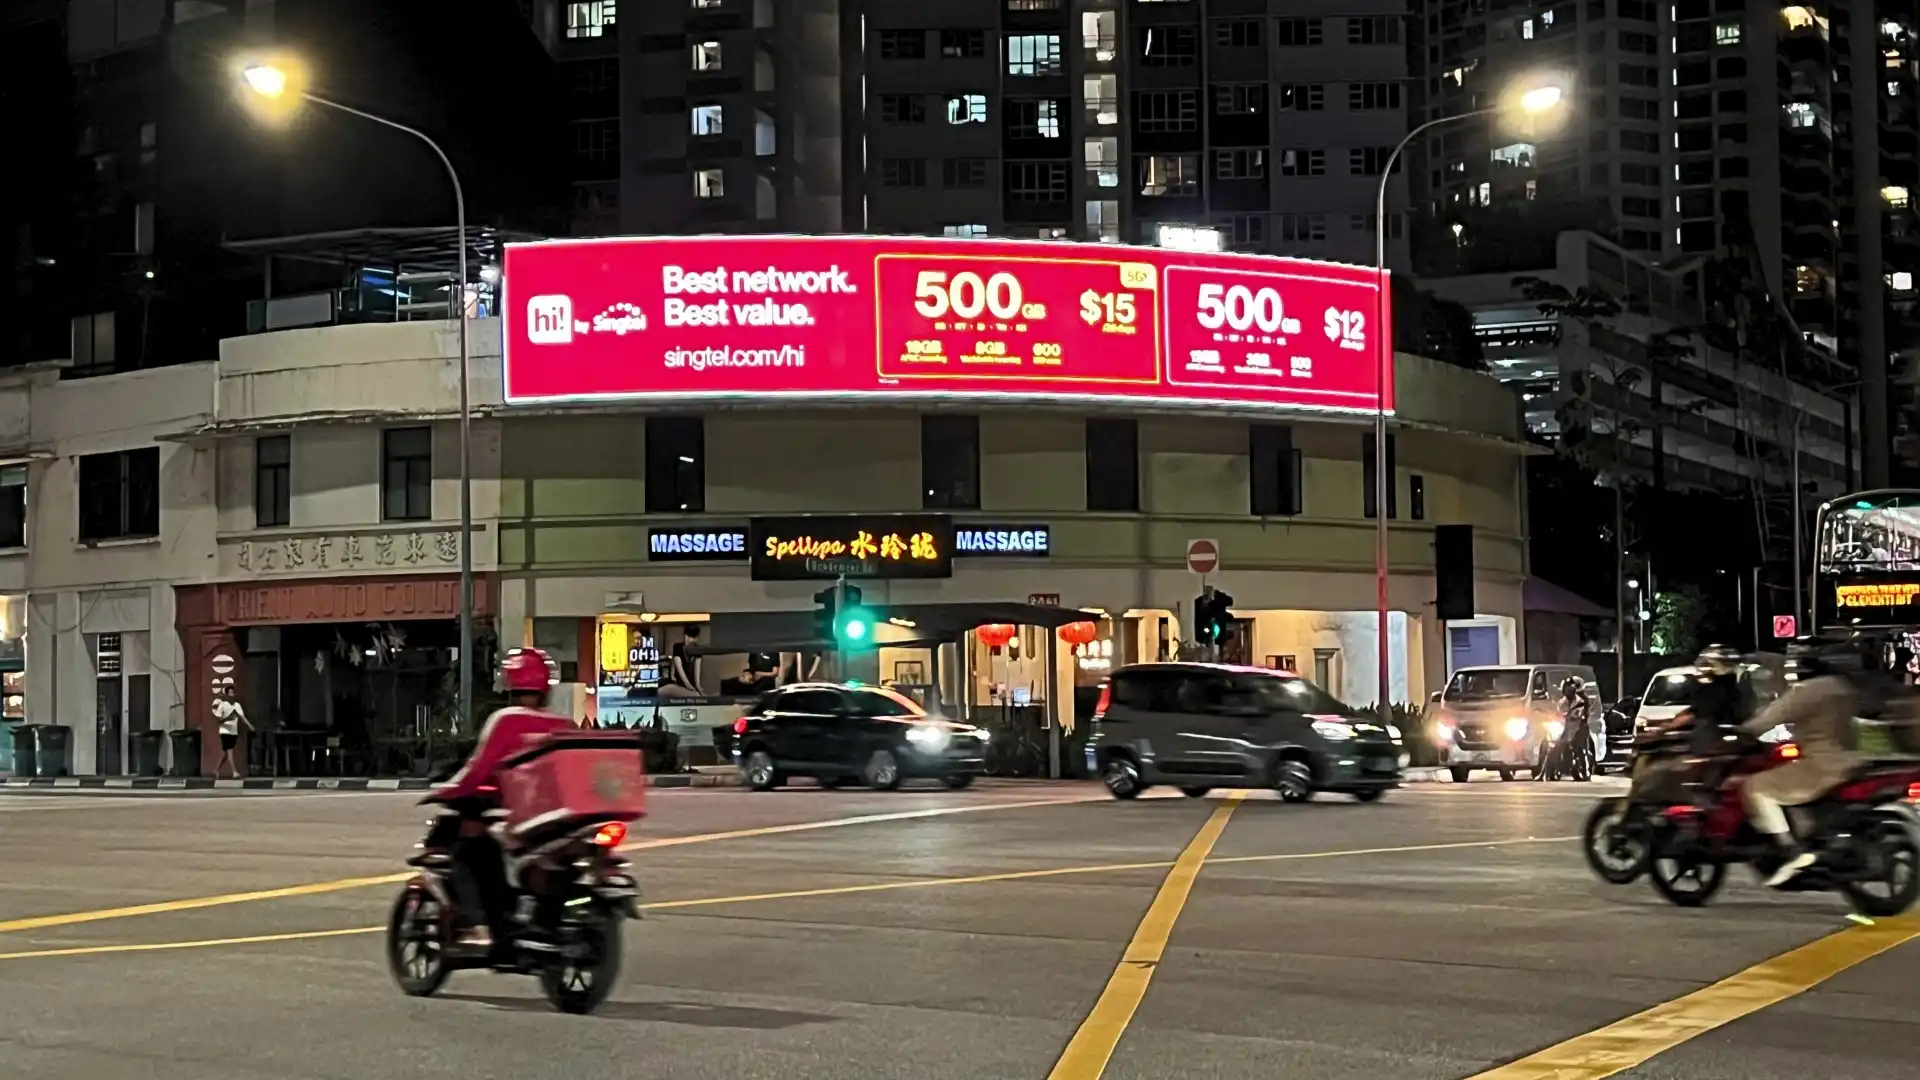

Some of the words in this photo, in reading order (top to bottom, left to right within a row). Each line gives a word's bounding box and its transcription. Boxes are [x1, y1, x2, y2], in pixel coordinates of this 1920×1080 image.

[663, 266, 728, 293] Best
[732, 265, 857, 293] network.
[534, 306, 565, 333] hi!
[593, 313, 647, 335] Singtel
[664, 298, 729, 326] Best
[732, 298, 815, 326] value.
[1079, 288, 1136, 325] $15
[1323, 306, 1366, 342] $12
[663, 345, 805, 371] singtel.com/hi
[650, 532, 745, 554] MASSAGE
[765, 536, 846, 560] Spellspa
[956, 530, 1048, 551] MASSAGE
[305, 585, 367, 618] AUTO
